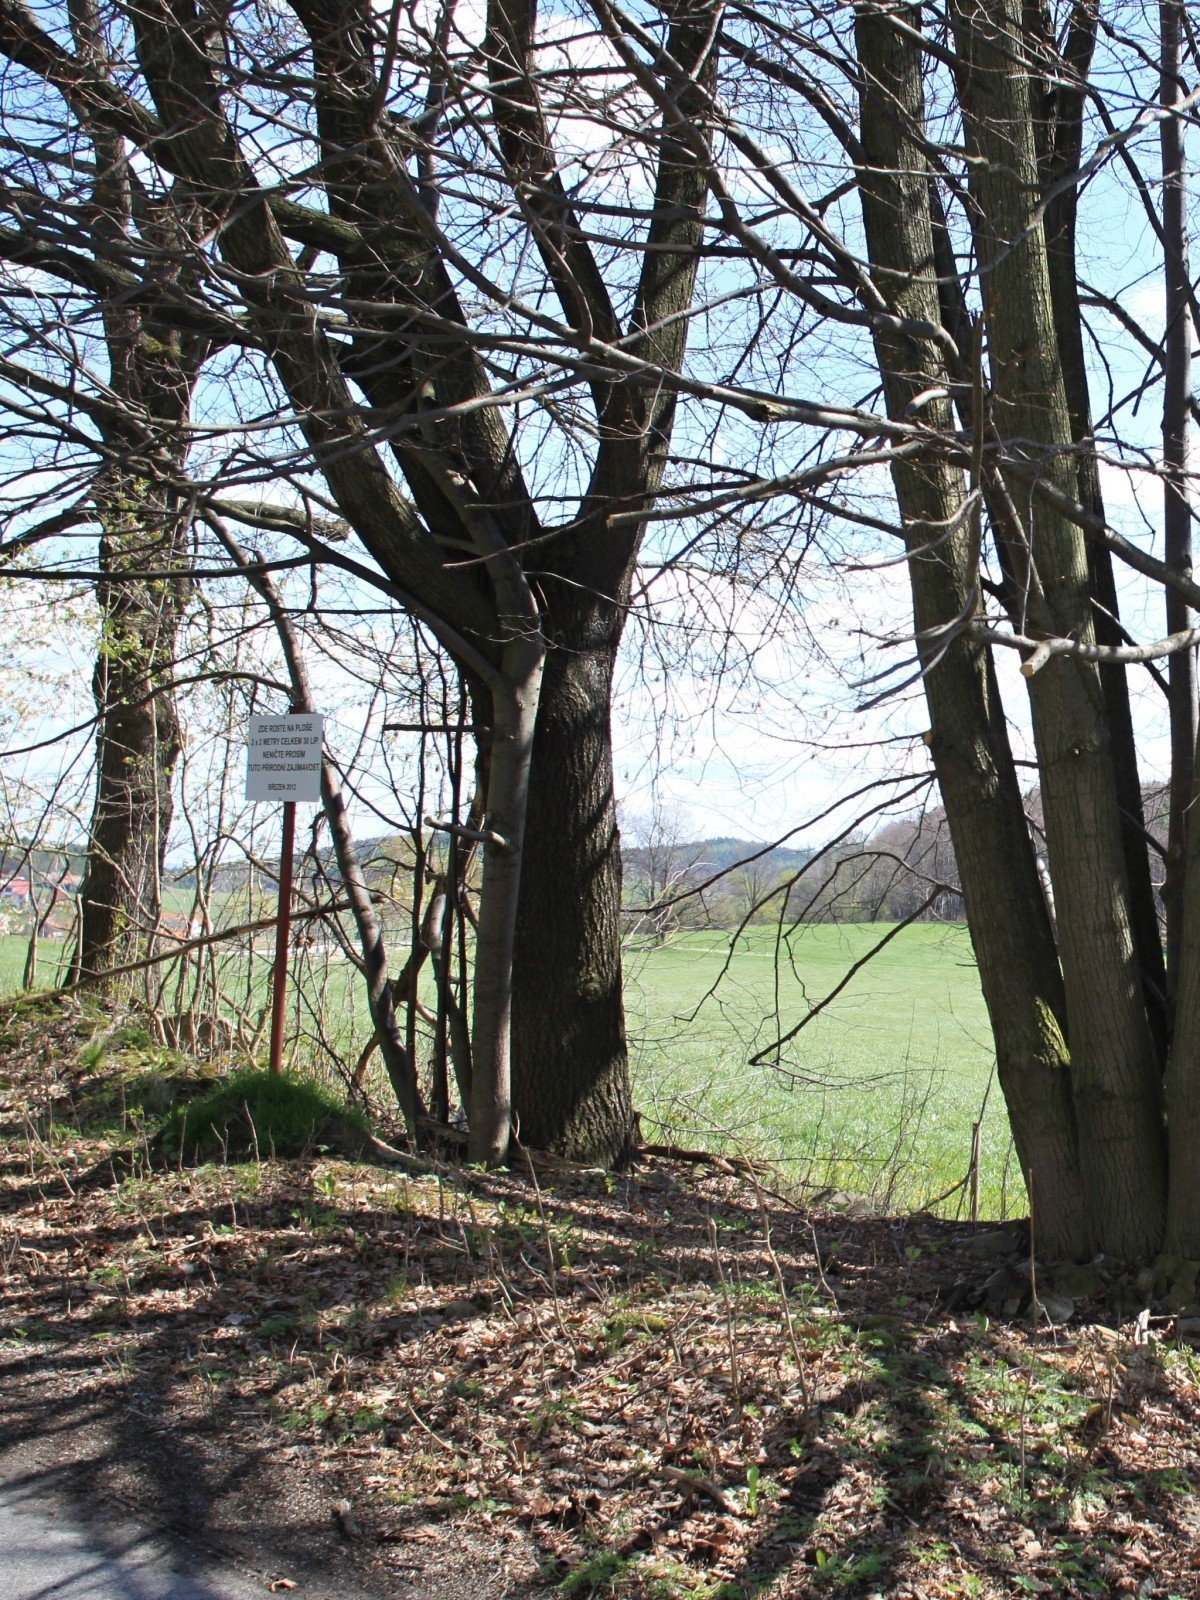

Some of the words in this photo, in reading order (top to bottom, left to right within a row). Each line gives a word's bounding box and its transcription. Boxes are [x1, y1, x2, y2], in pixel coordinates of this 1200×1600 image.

[296, 722, 313, 731] PLOŠE
[263, 750, 284, 758] NENIČTE
[262, 762, 286, 771] PŘÍRODNÍ
